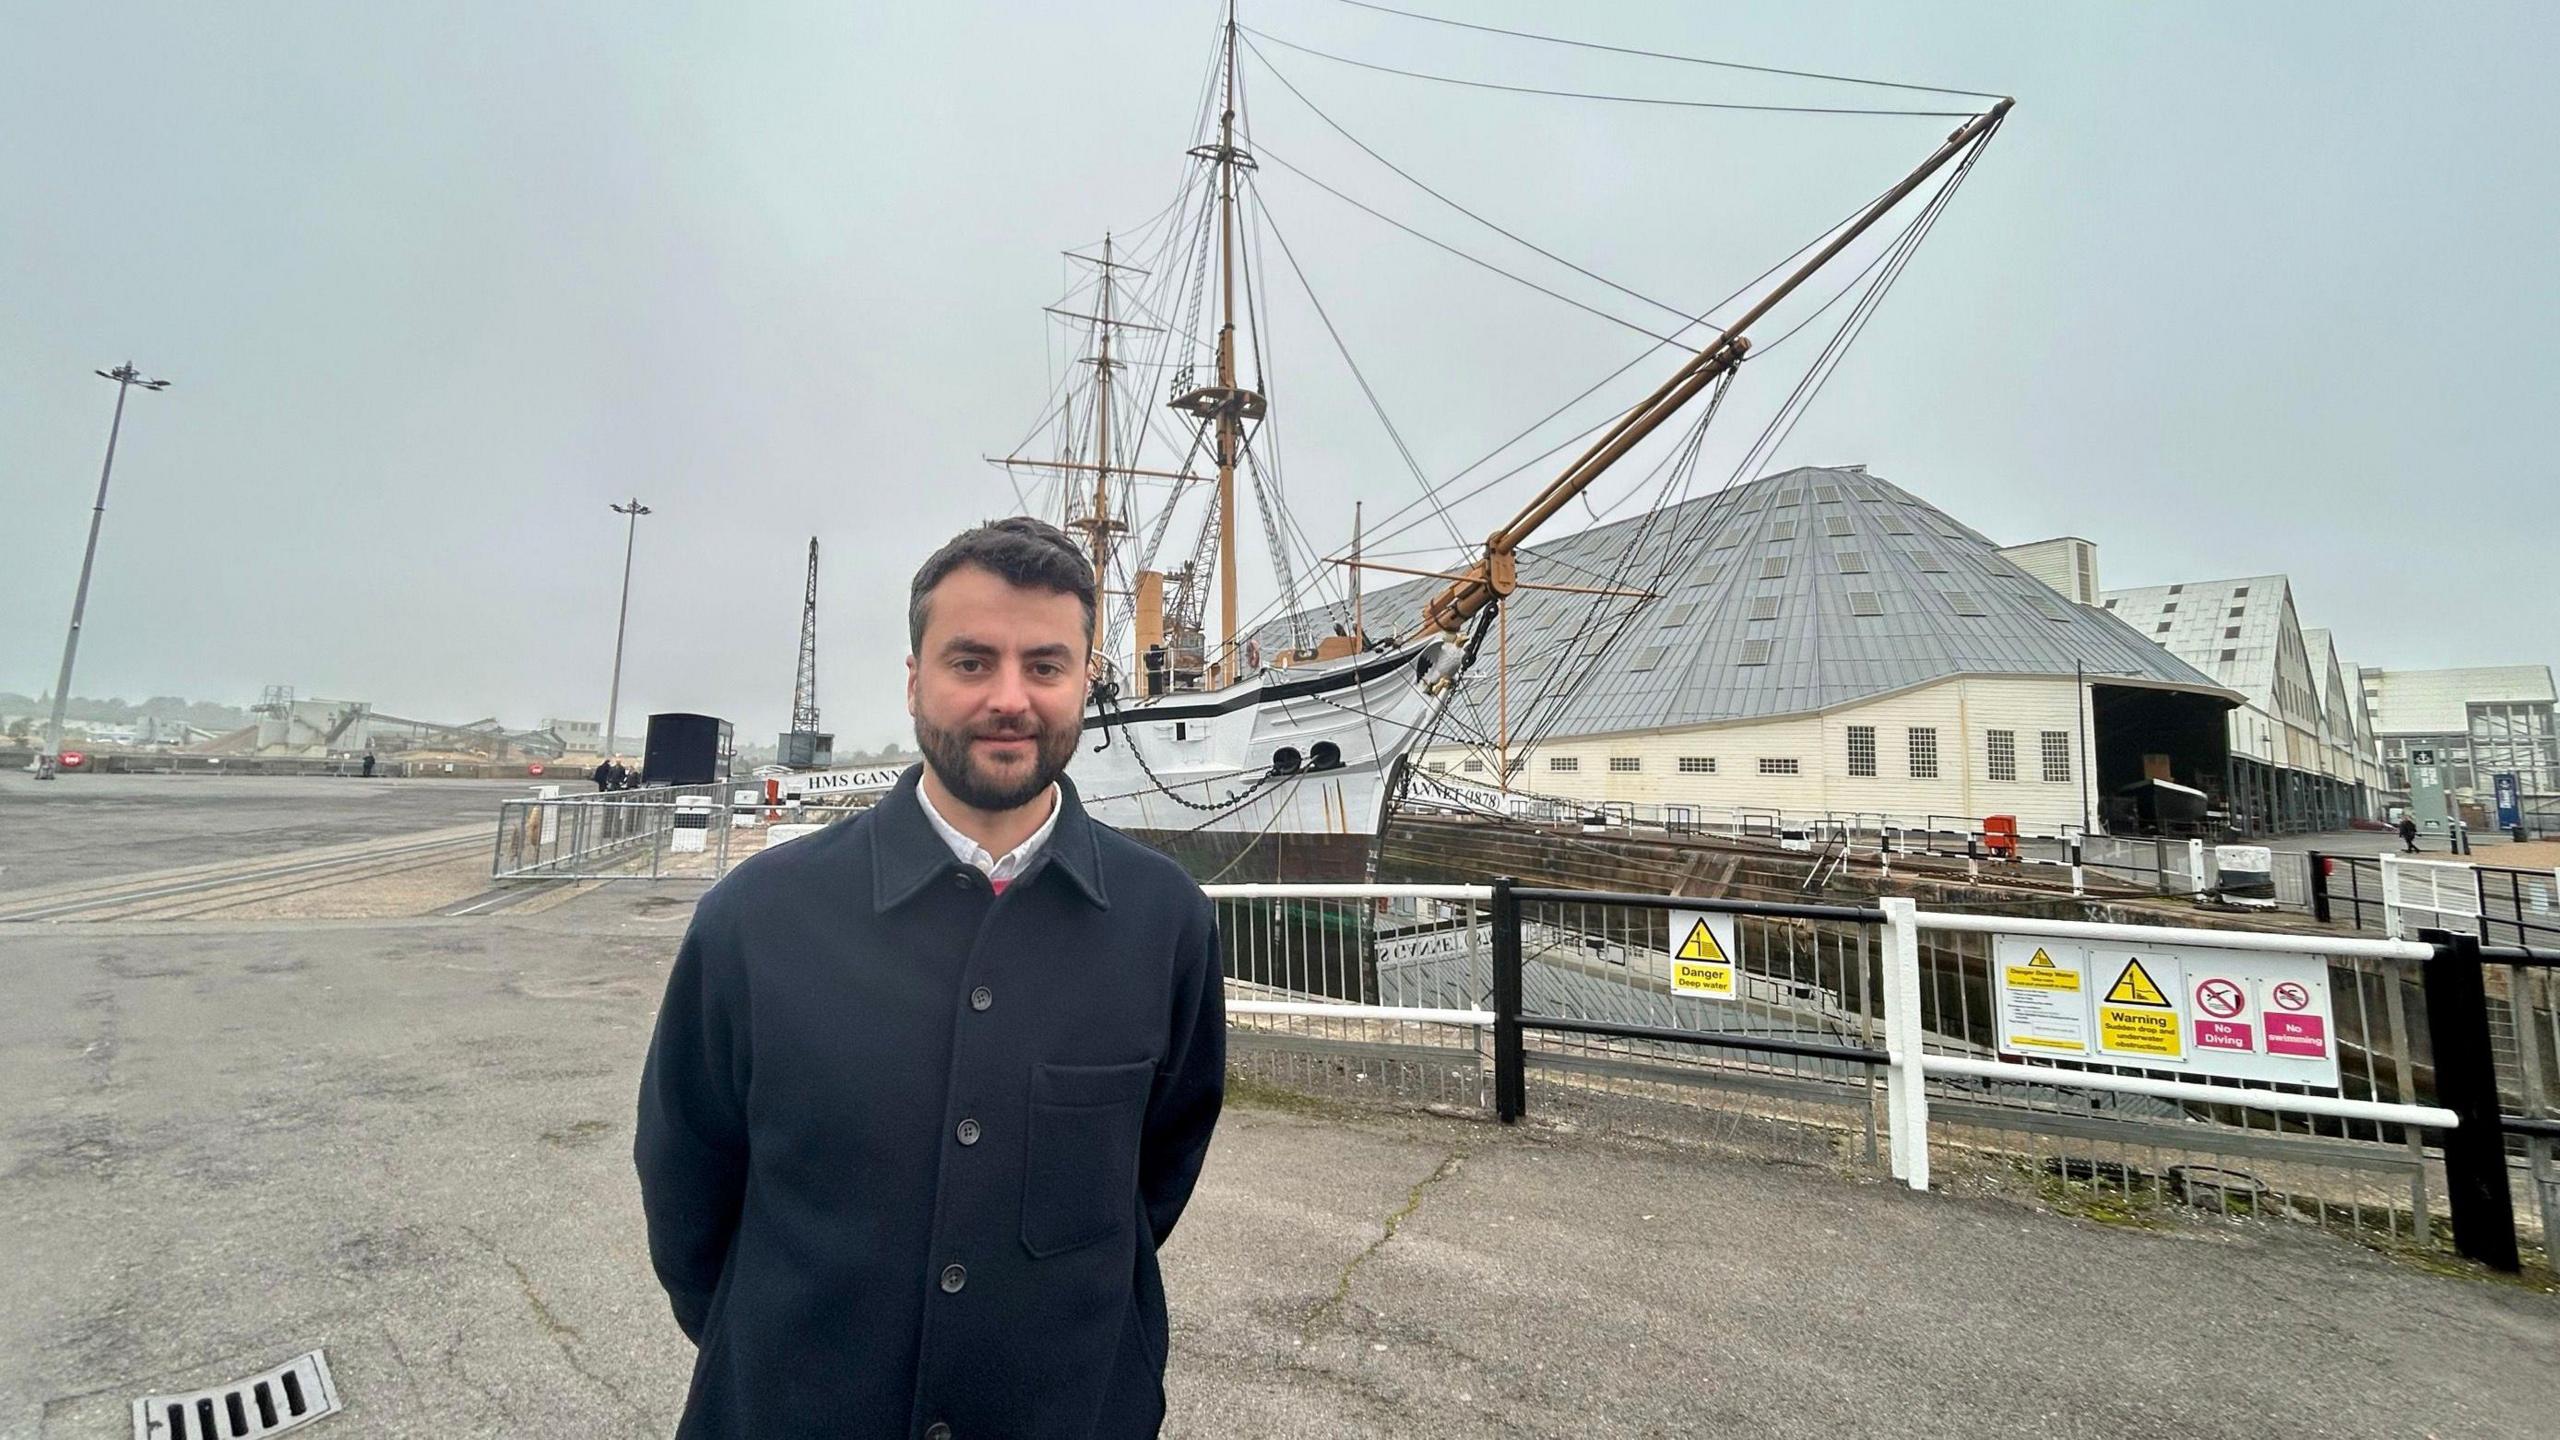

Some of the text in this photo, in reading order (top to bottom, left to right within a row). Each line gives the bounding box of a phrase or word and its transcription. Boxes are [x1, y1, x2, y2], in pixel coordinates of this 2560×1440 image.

[809, 769, 902, 789] HMS GANN
[1464, 788, 1501, 811] (1878)
[1682, 966, 1724, 980] Danger
[1679, 978, 1727, 990] Deep water
[2111, 1012, 2167, 1027] Warning
[2105, 1022, 2136, 1031] Sudden
[2138, 1026, 2157, 1034] drop
[2214, 1024, 2232, 1034] No
[2286, 1023, 2302, 1033] No
[2116, 1033, 2164, 1042] underwater
[2205, 1033, 2243, 1047] Diving
[2268, 1033, 2323, 1047] swimming
[2115, 1041, 2167, 1051] obstructions
